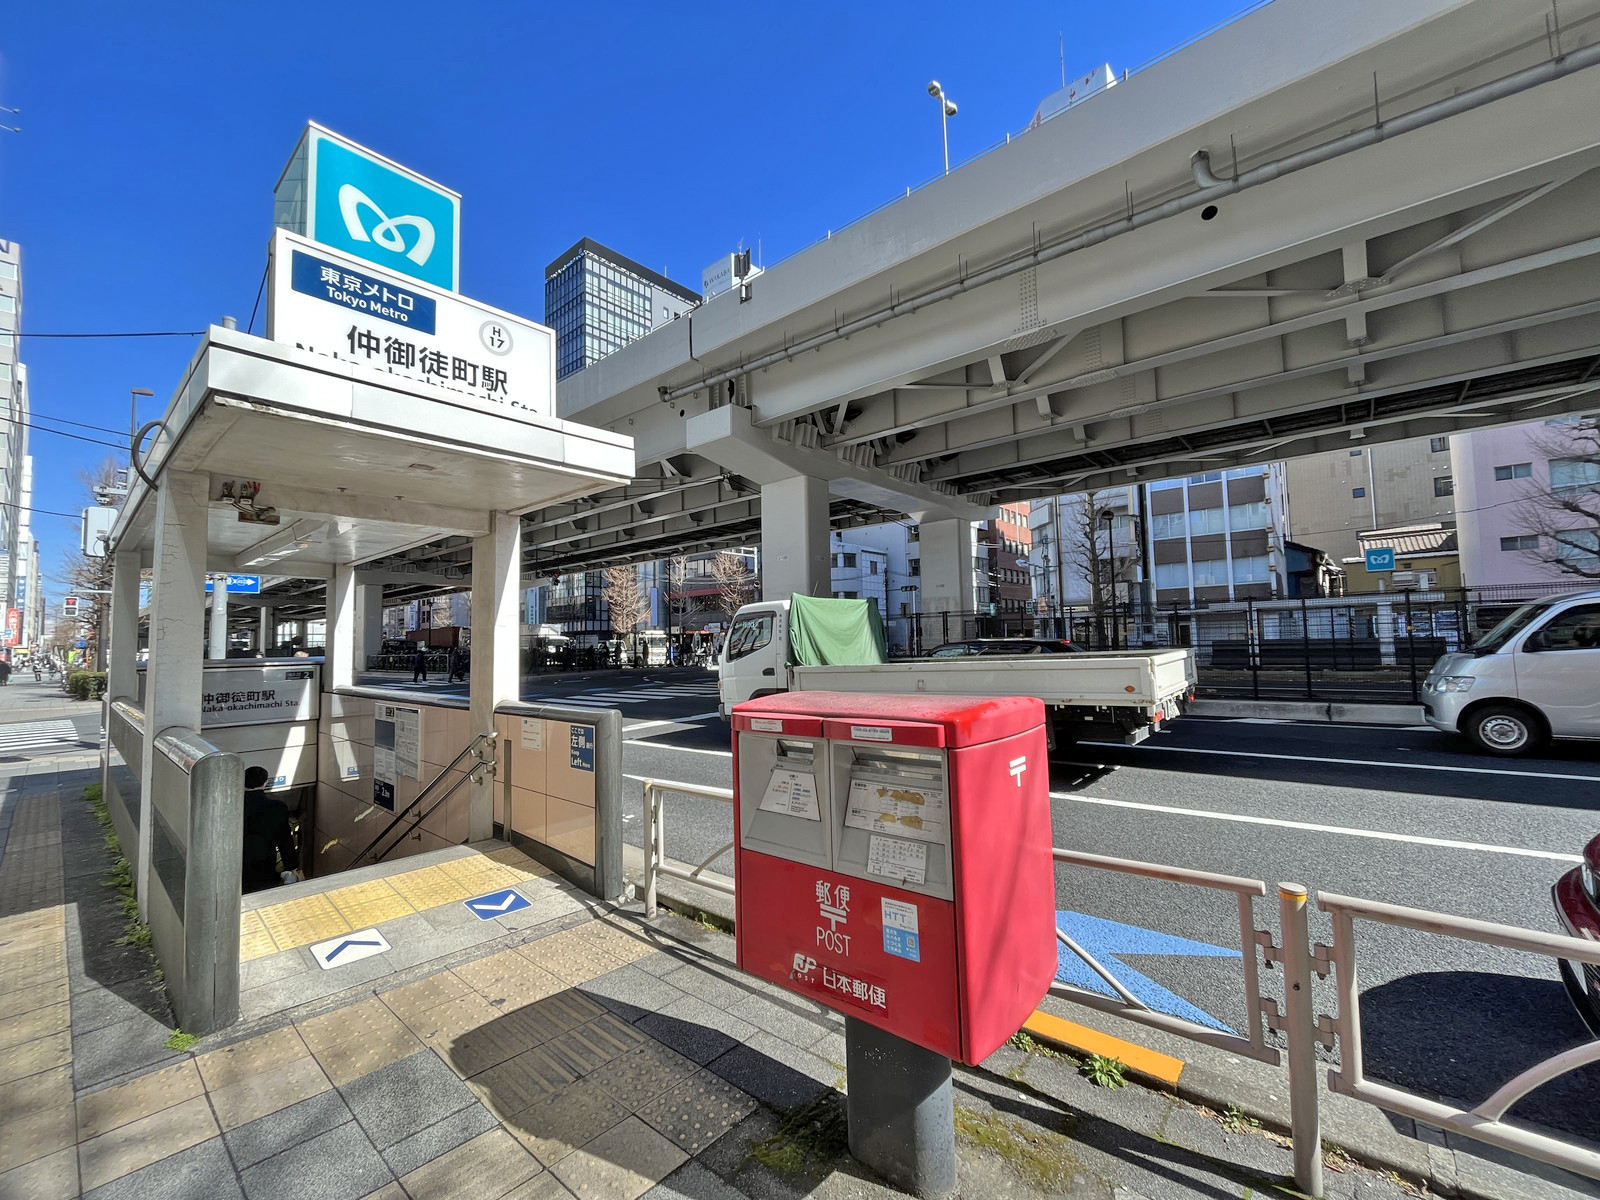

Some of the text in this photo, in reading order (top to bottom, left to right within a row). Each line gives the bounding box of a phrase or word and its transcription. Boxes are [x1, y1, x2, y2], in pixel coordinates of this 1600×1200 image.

[320, 265, 414, 311] 東京メトロ
[326, 286, 409, 323] Tokyo Metro
[489, 336, 505, 350] 17
[492, 326, 501, 338] H
[346, 325, 509, 396] 仲御徒町駅
[303, 671, 310, 679] 2
[571, 757, 582, 767] Left
[815, 880, 851, 912] 郵便
[884, 910, 907, 923] HTT
[816, 926, 851, 957] POST
[823, 966, 887, 1009] 日本郵便
